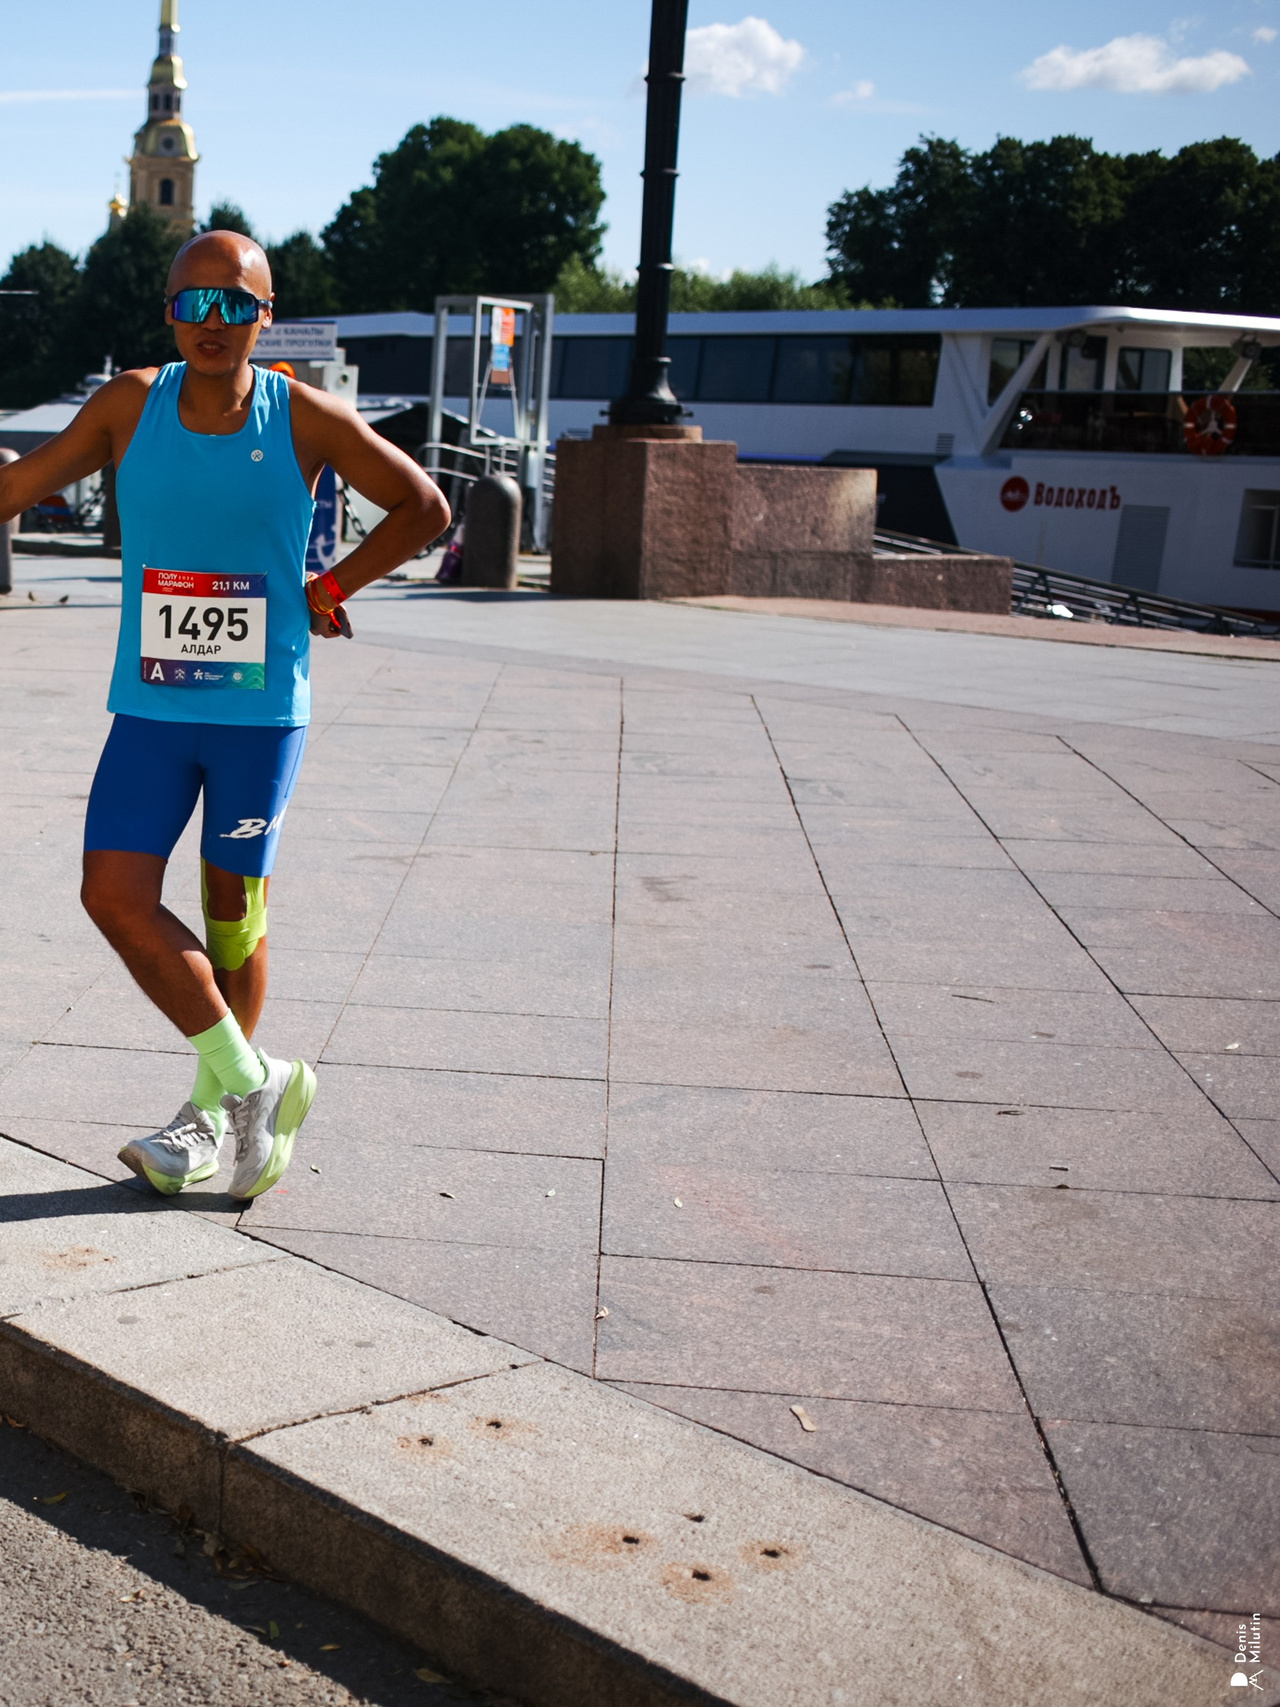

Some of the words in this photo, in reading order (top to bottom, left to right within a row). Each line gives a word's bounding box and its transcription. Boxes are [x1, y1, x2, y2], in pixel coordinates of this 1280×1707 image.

[158, 572, 178, 581] ПОЛУ
[157, 579, 195, 589] МАРАФОН
[212, 581, 230, 592] 21,1
[233, 581, 250, 590] КМ
[159, 604, 249, 642] 1495
[180, 644, 222, 656] АЛДАР
